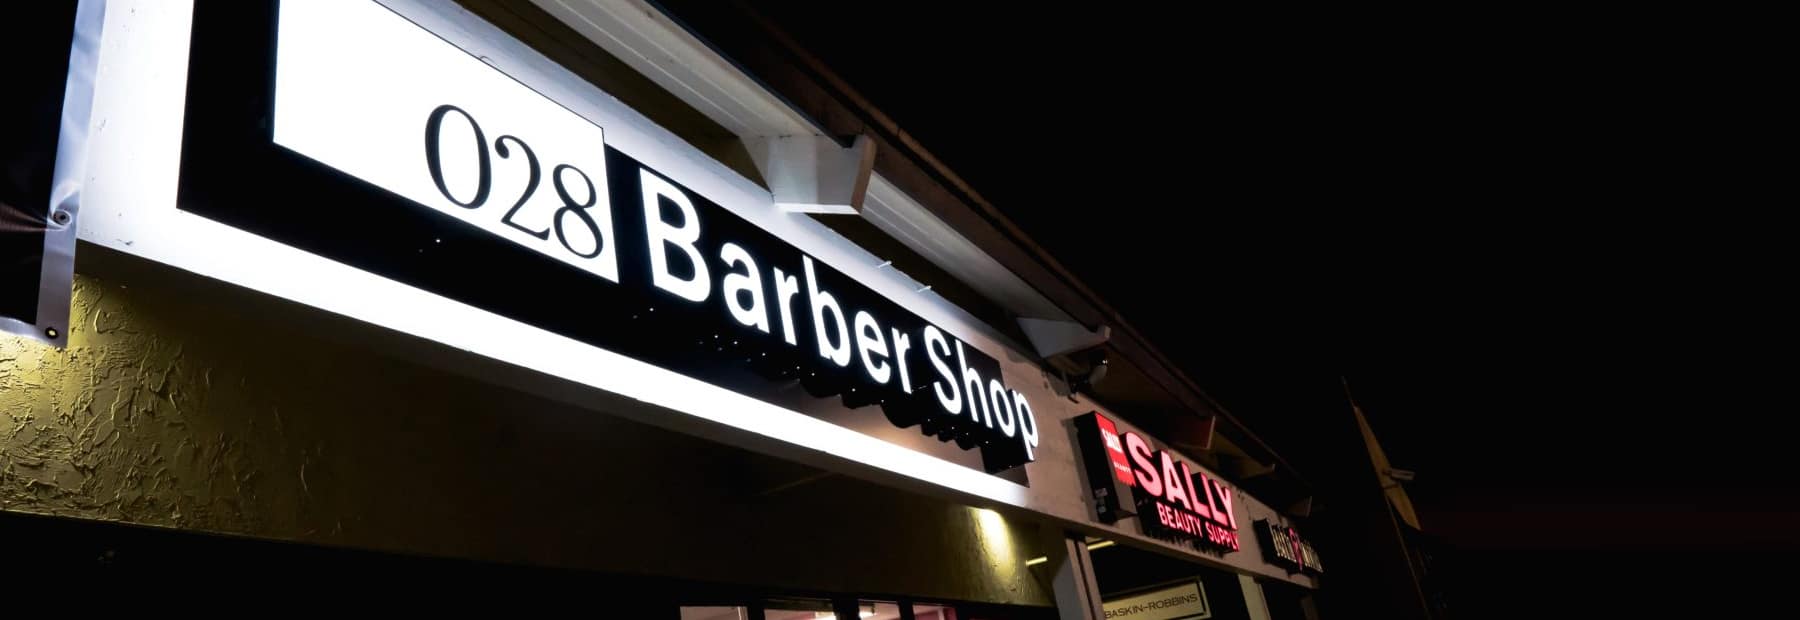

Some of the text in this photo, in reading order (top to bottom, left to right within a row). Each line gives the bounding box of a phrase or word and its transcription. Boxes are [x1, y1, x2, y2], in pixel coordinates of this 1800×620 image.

[425, 104, 1040, 459] 028 Barber Shop
[1126, 431, 1238, 530] SALLY
[1156, 501, 1203, 538] BEAUTY
[1205, 521, 1239, 551] SUPPLY
[1104, 594, 1198, 619] BASKIN-ROBBINS
